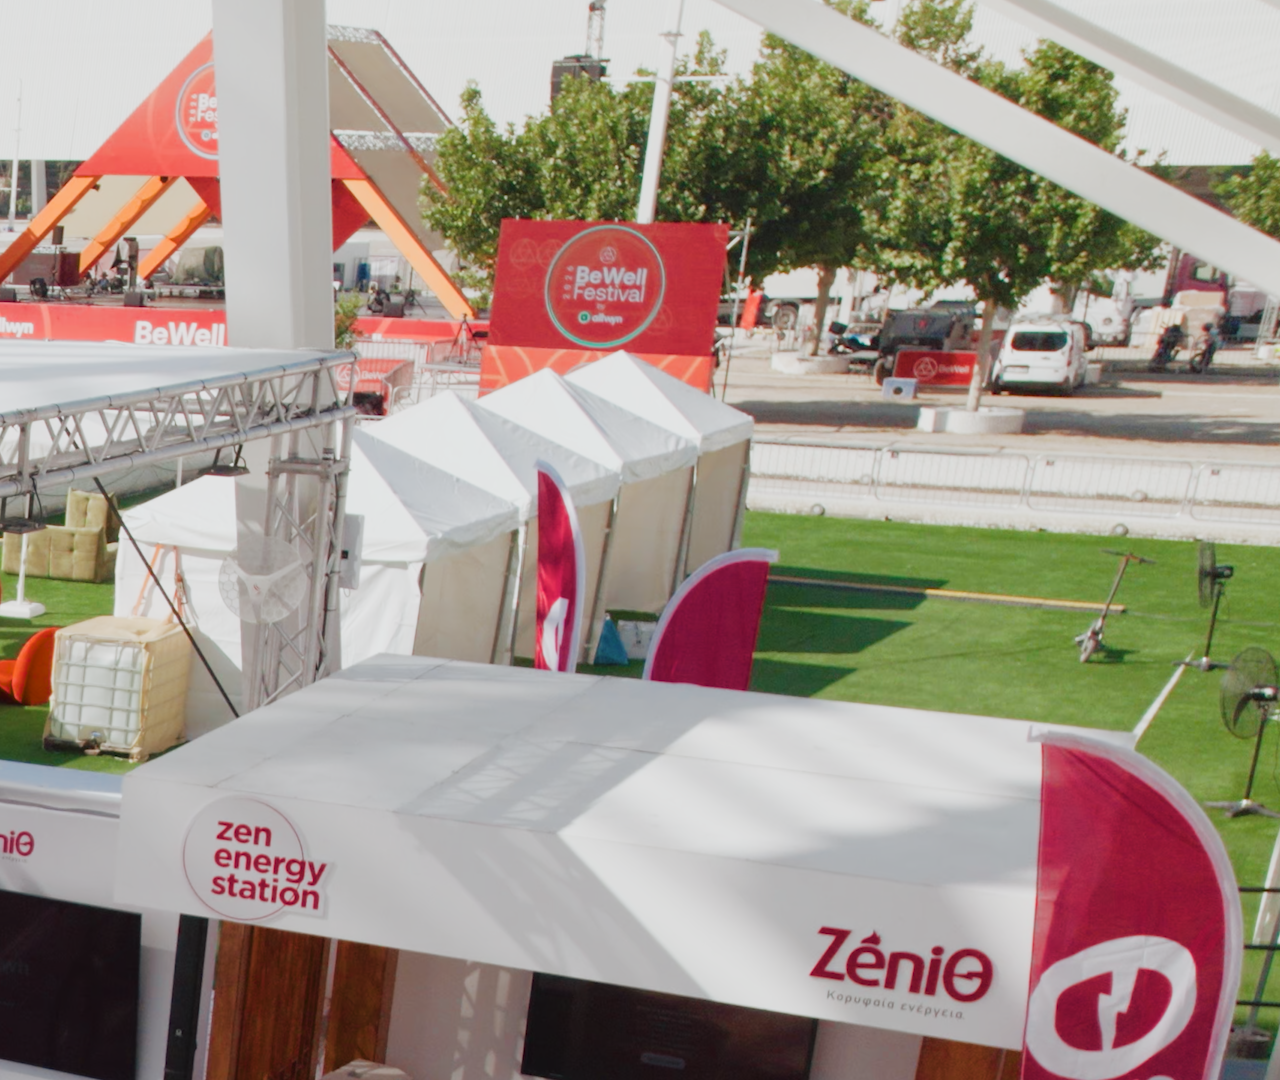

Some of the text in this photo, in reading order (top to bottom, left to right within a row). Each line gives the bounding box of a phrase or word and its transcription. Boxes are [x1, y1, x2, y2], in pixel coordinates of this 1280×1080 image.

[575, 265, 647, 287] BeWell
[573, 284, 645, 303] Festival
[134, 320, 225, 346] BeWell
[216, 820, 272, 847] zen
[214, 848, 327, 886] energy
[211, 873, 320, 910] station
[826, 990, 895, 1010] Κορυφαία
